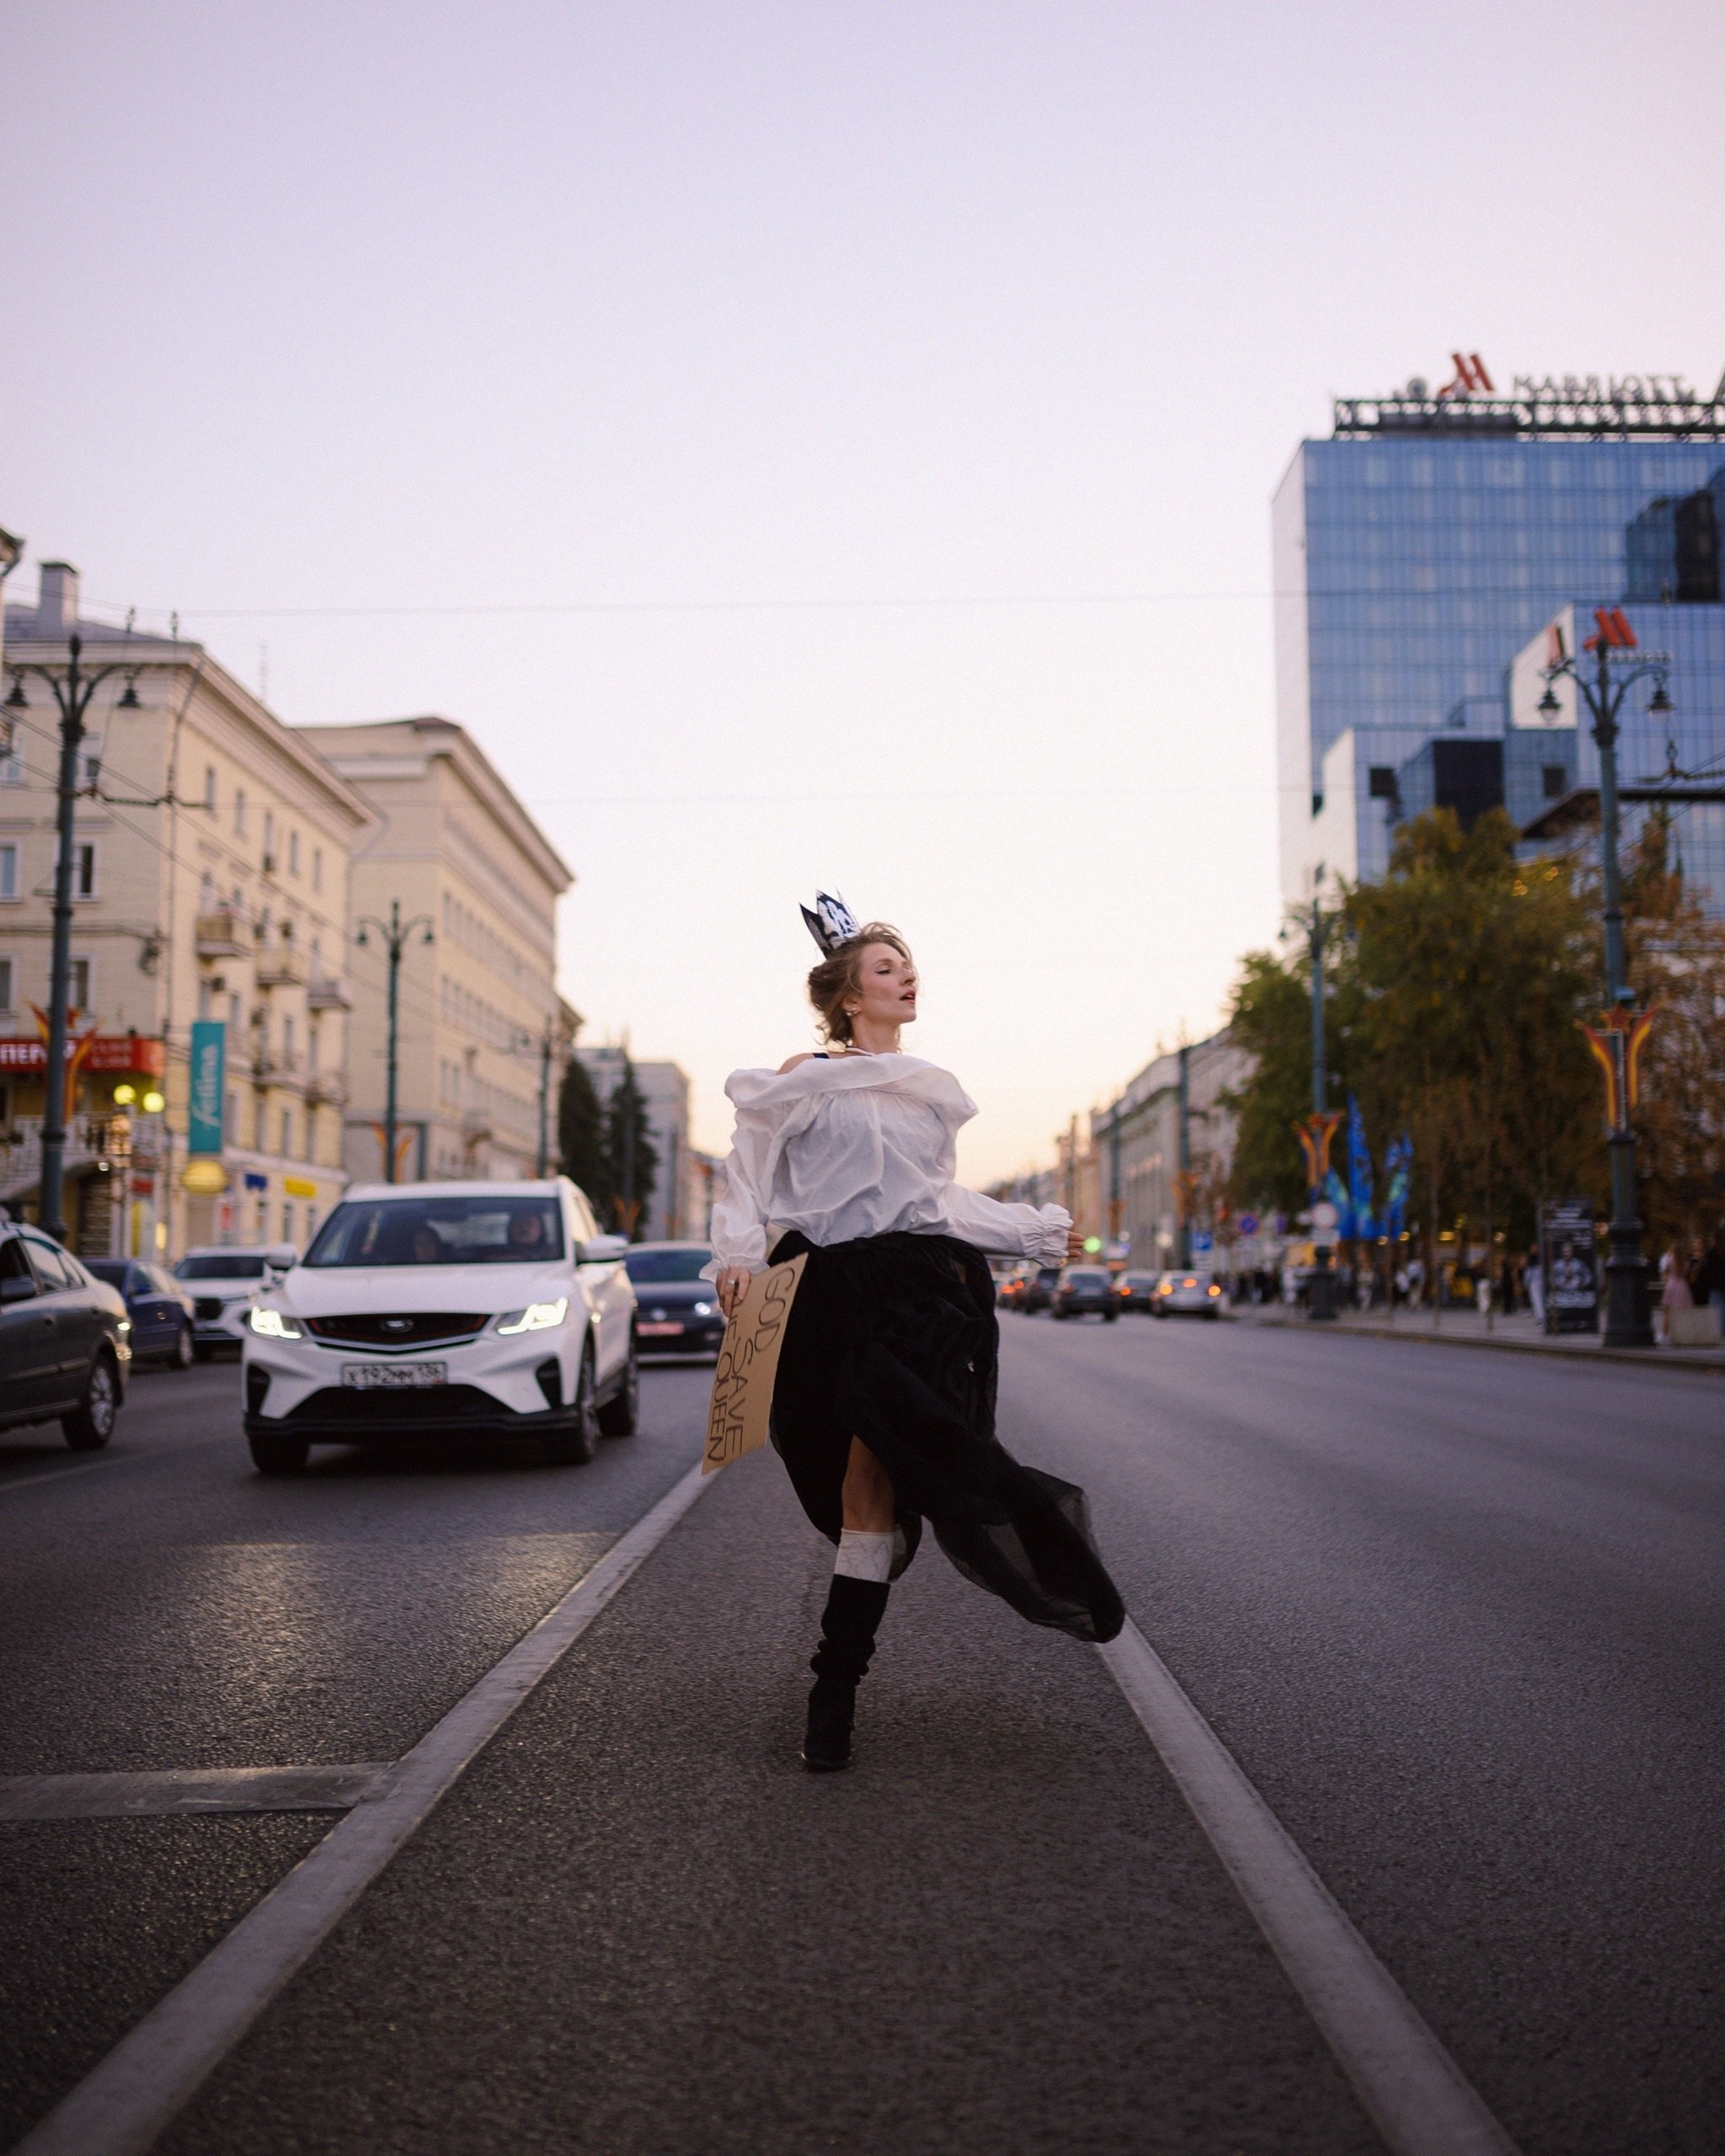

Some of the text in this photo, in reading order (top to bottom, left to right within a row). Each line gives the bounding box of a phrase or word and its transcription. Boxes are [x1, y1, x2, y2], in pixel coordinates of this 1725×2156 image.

[754, 1267, 795, 1353] GOD
[708, 1351, 732, 1461] QUEEN
[724, 1336, 754, 1458] SAVE
